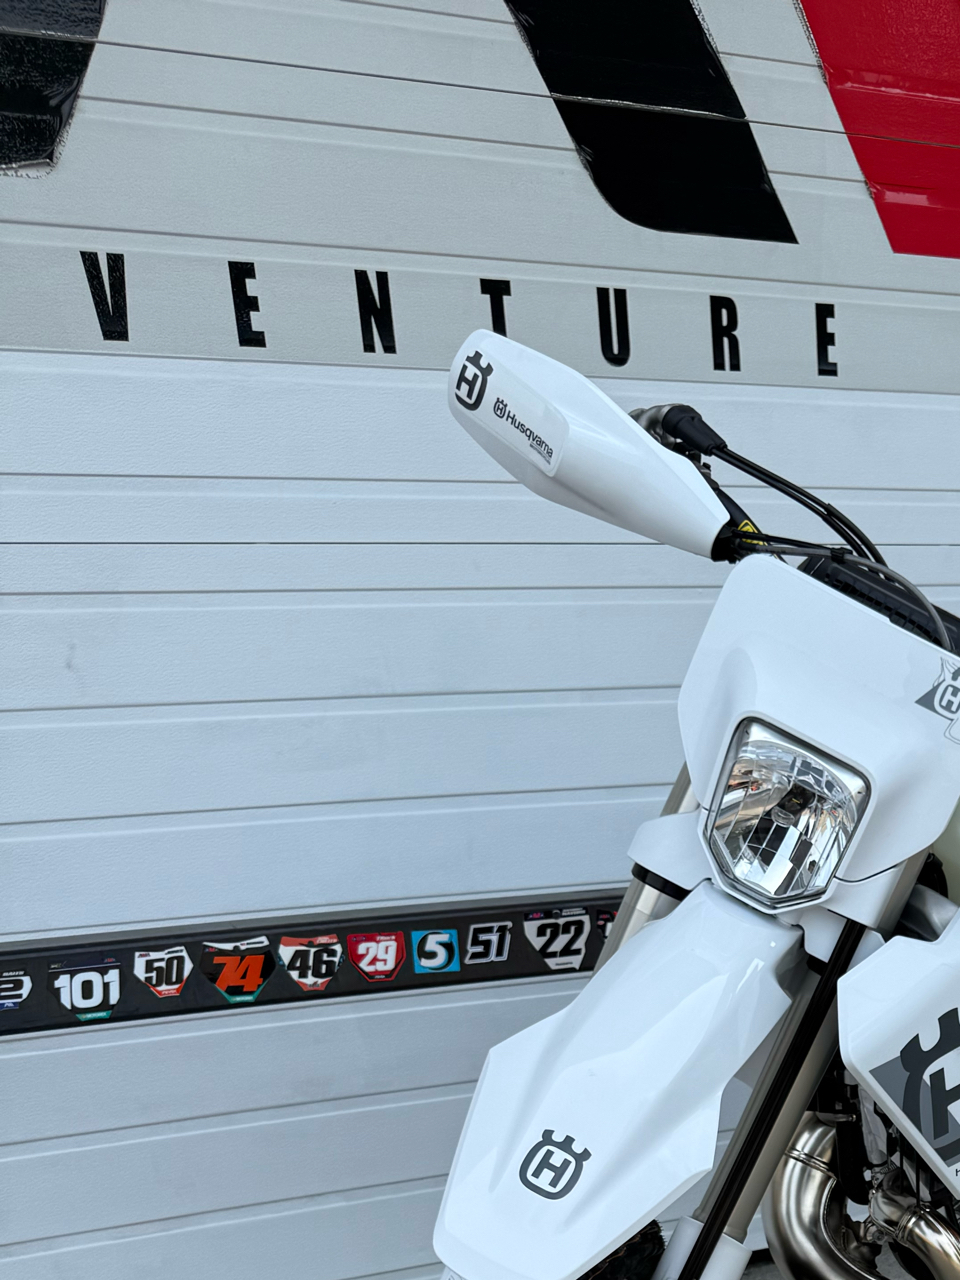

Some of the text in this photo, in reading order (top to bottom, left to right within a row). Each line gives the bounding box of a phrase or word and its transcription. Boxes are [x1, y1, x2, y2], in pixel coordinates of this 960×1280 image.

[80, 251, 837, 377] VENTURE
[505, 410, 553, 458] Husqvarna
[357, 940, 398, 973] 29
[420, 934, 450, 969] 5
[467, 924, 511, 962] 51
[536, 919, 585, 959] 22
[145, 955, 185, 988] 50
[213, 954, 265, 993] 74
[286, 947, 338, 979] 46
[54, 969, 120, 1010] 101
